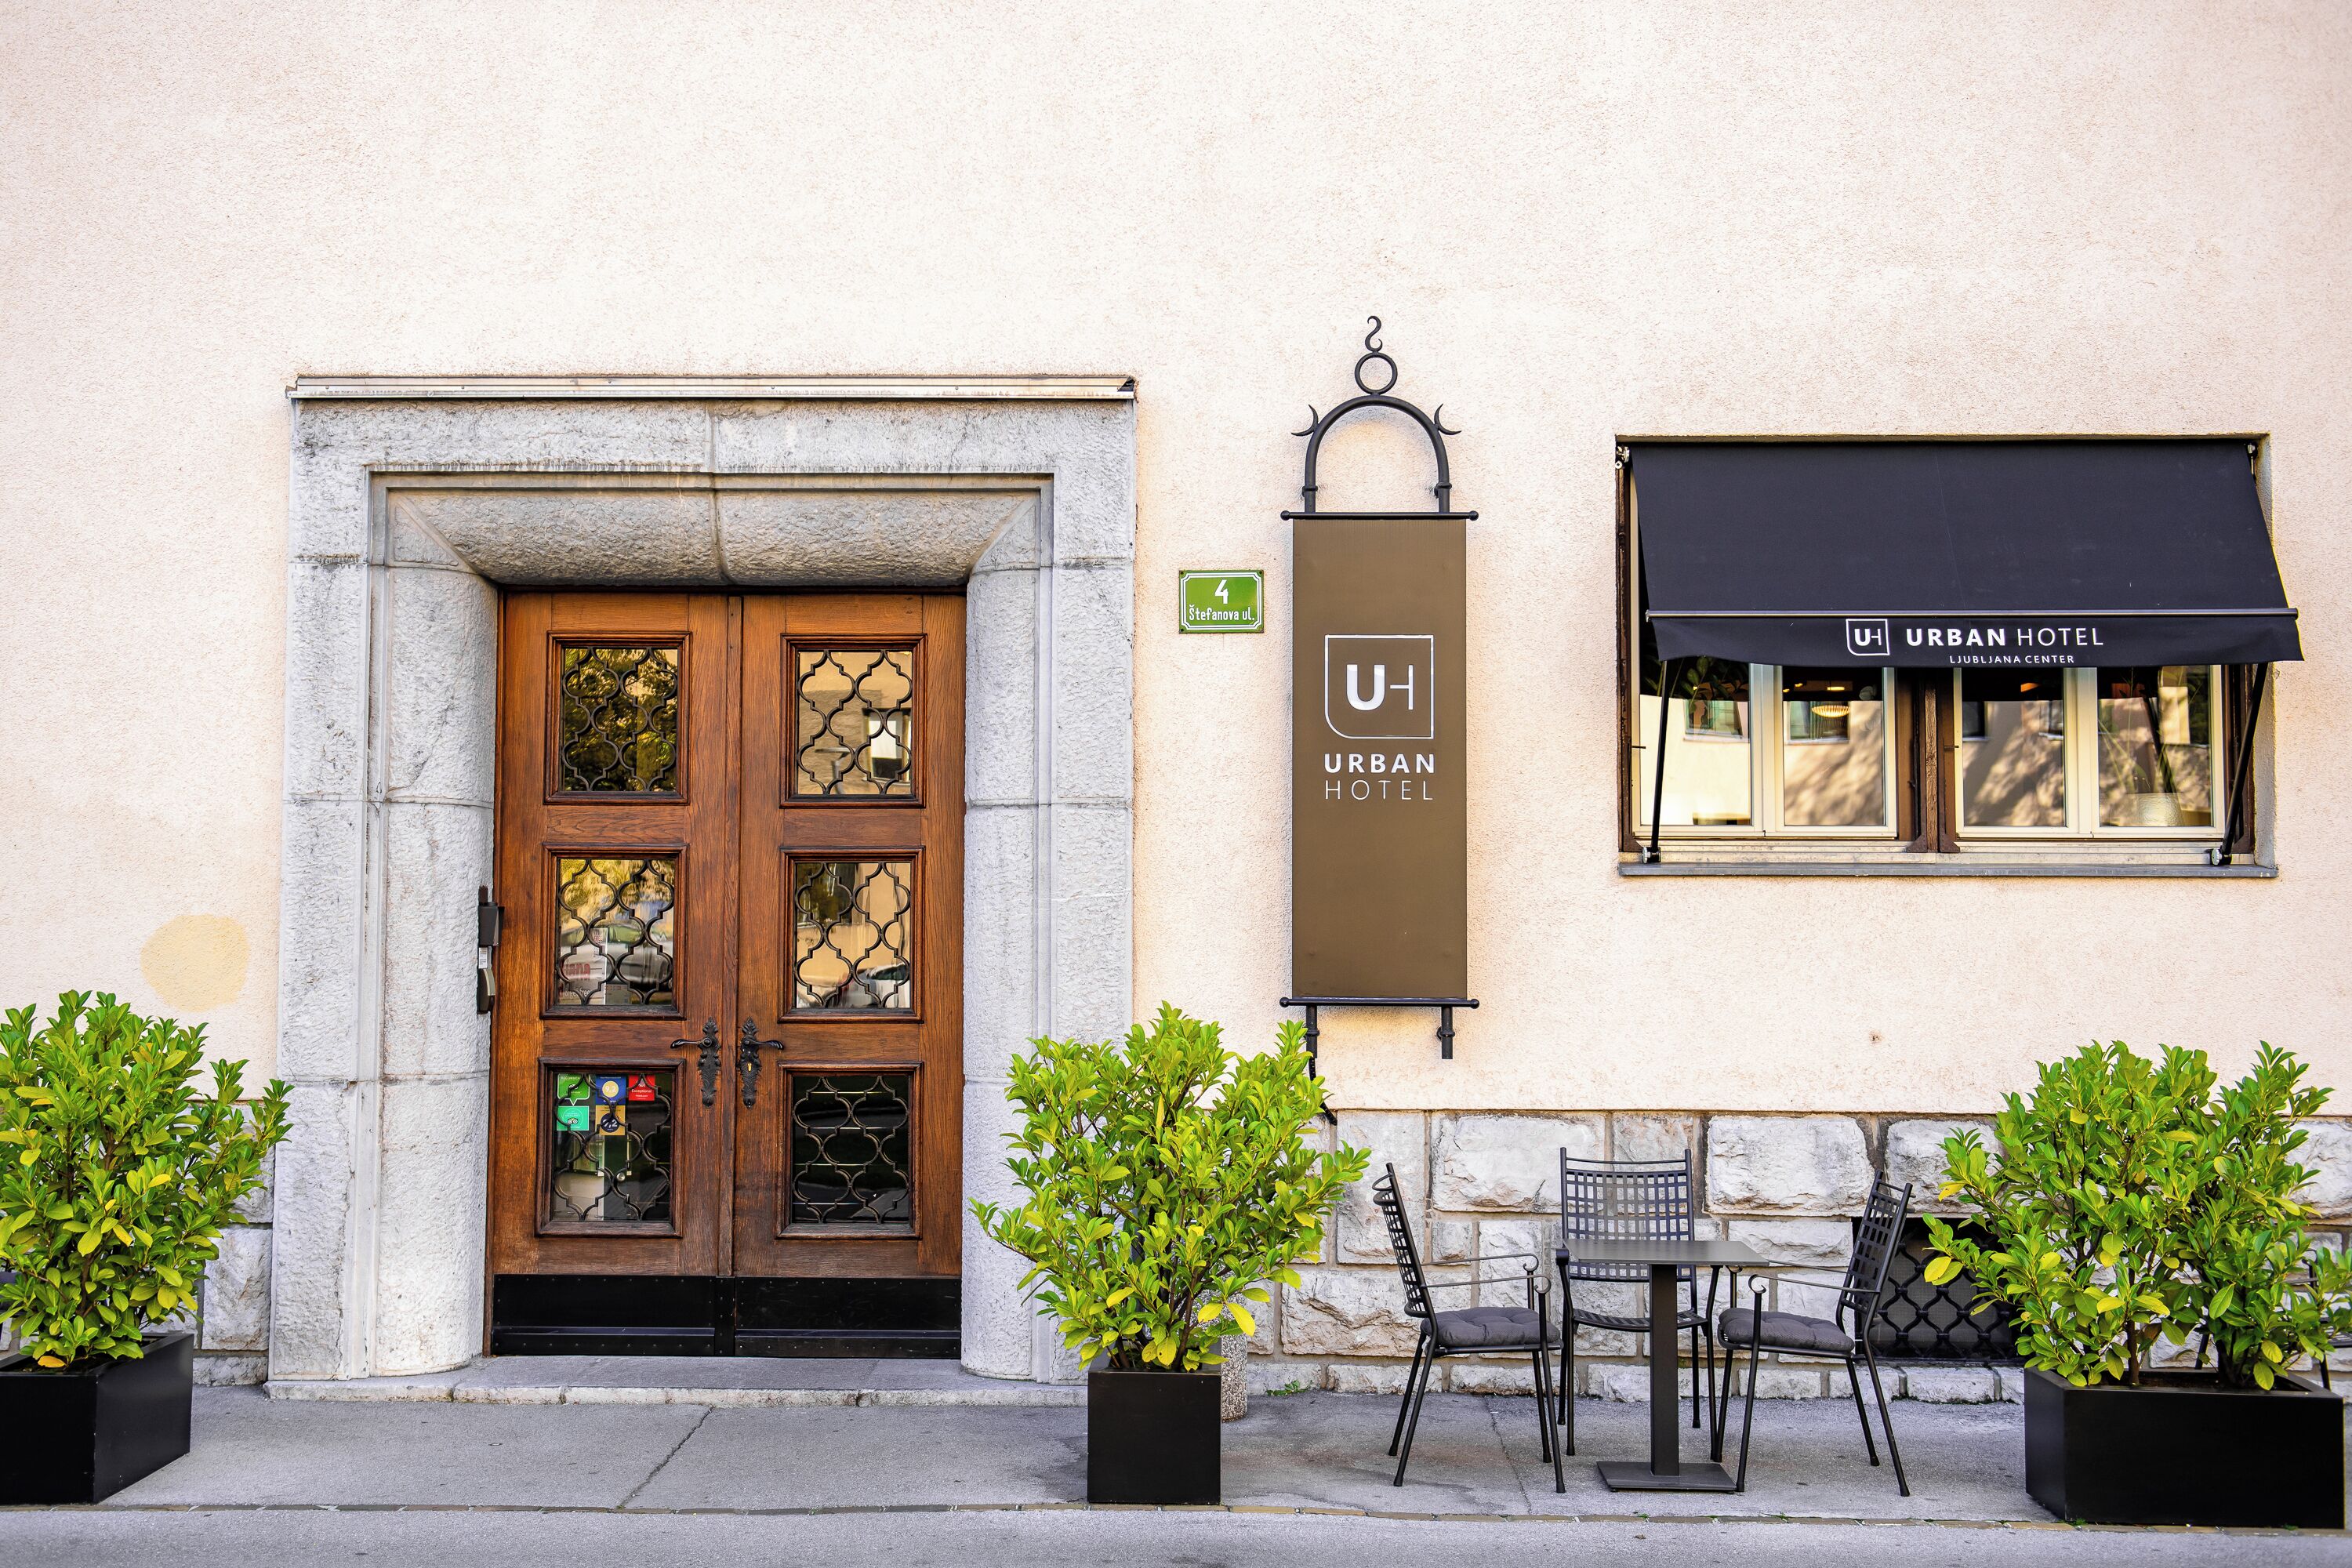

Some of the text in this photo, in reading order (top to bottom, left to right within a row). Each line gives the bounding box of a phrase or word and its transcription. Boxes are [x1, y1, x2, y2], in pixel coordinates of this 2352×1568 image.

[1214, 579, 1229, 604] 4
[1189, 604, 1255, 621] Štefanova ul.
[1854, 628, 1882, 647] UH
[1906, 628, 2104, 647] URBAN HOTEL
[1950, 655, 2074, 664] LJUBLJANA CENTER
[1346, 664, 1414, 711] UH
[1324, 753, 1435, 774] URBAN
[1325, 780, 1434, 800] HOTEL
